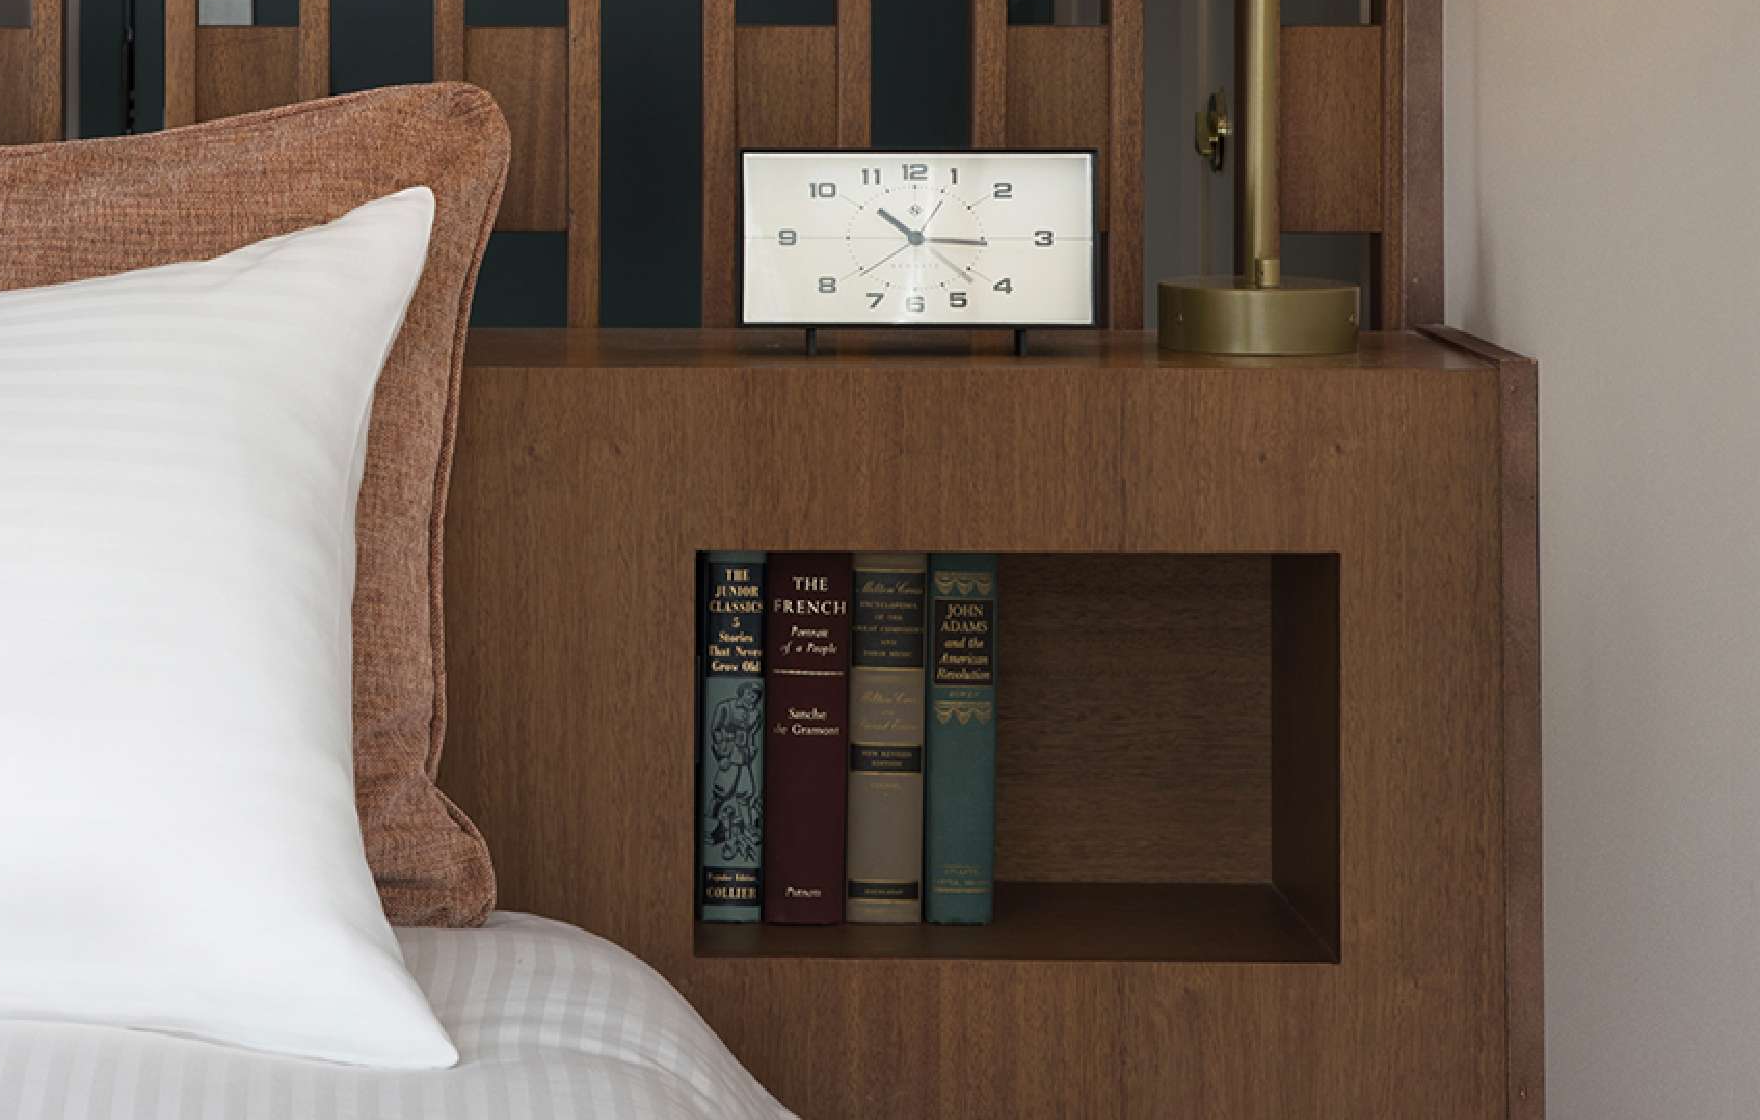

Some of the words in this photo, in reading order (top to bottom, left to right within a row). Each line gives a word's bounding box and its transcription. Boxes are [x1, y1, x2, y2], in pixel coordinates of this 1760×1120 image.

[862, 168, 880, 185] 11
[901, 164, 927, 181] 12
[951, 167, 958, 185] 1
[810, 183, 835, 198] 10
[993, 183, 1012, 199] 2
[778, 229, 796, 246] 9
[1035, 231, 1054, 247] 3
[819, 278, 837, 293] 8
[993, 278, 1012, 293] 4
[866, 293, 883, 309] 7
[906, 296, 925, 313] 6
[950, 292, 968, 307] 5
[792, 576, 829, 592] THE
[774, 600, 847, 615] FRENCH
[947, 604, 984, 619] JOHN
[940, 620, 988, 632] ADAMS
